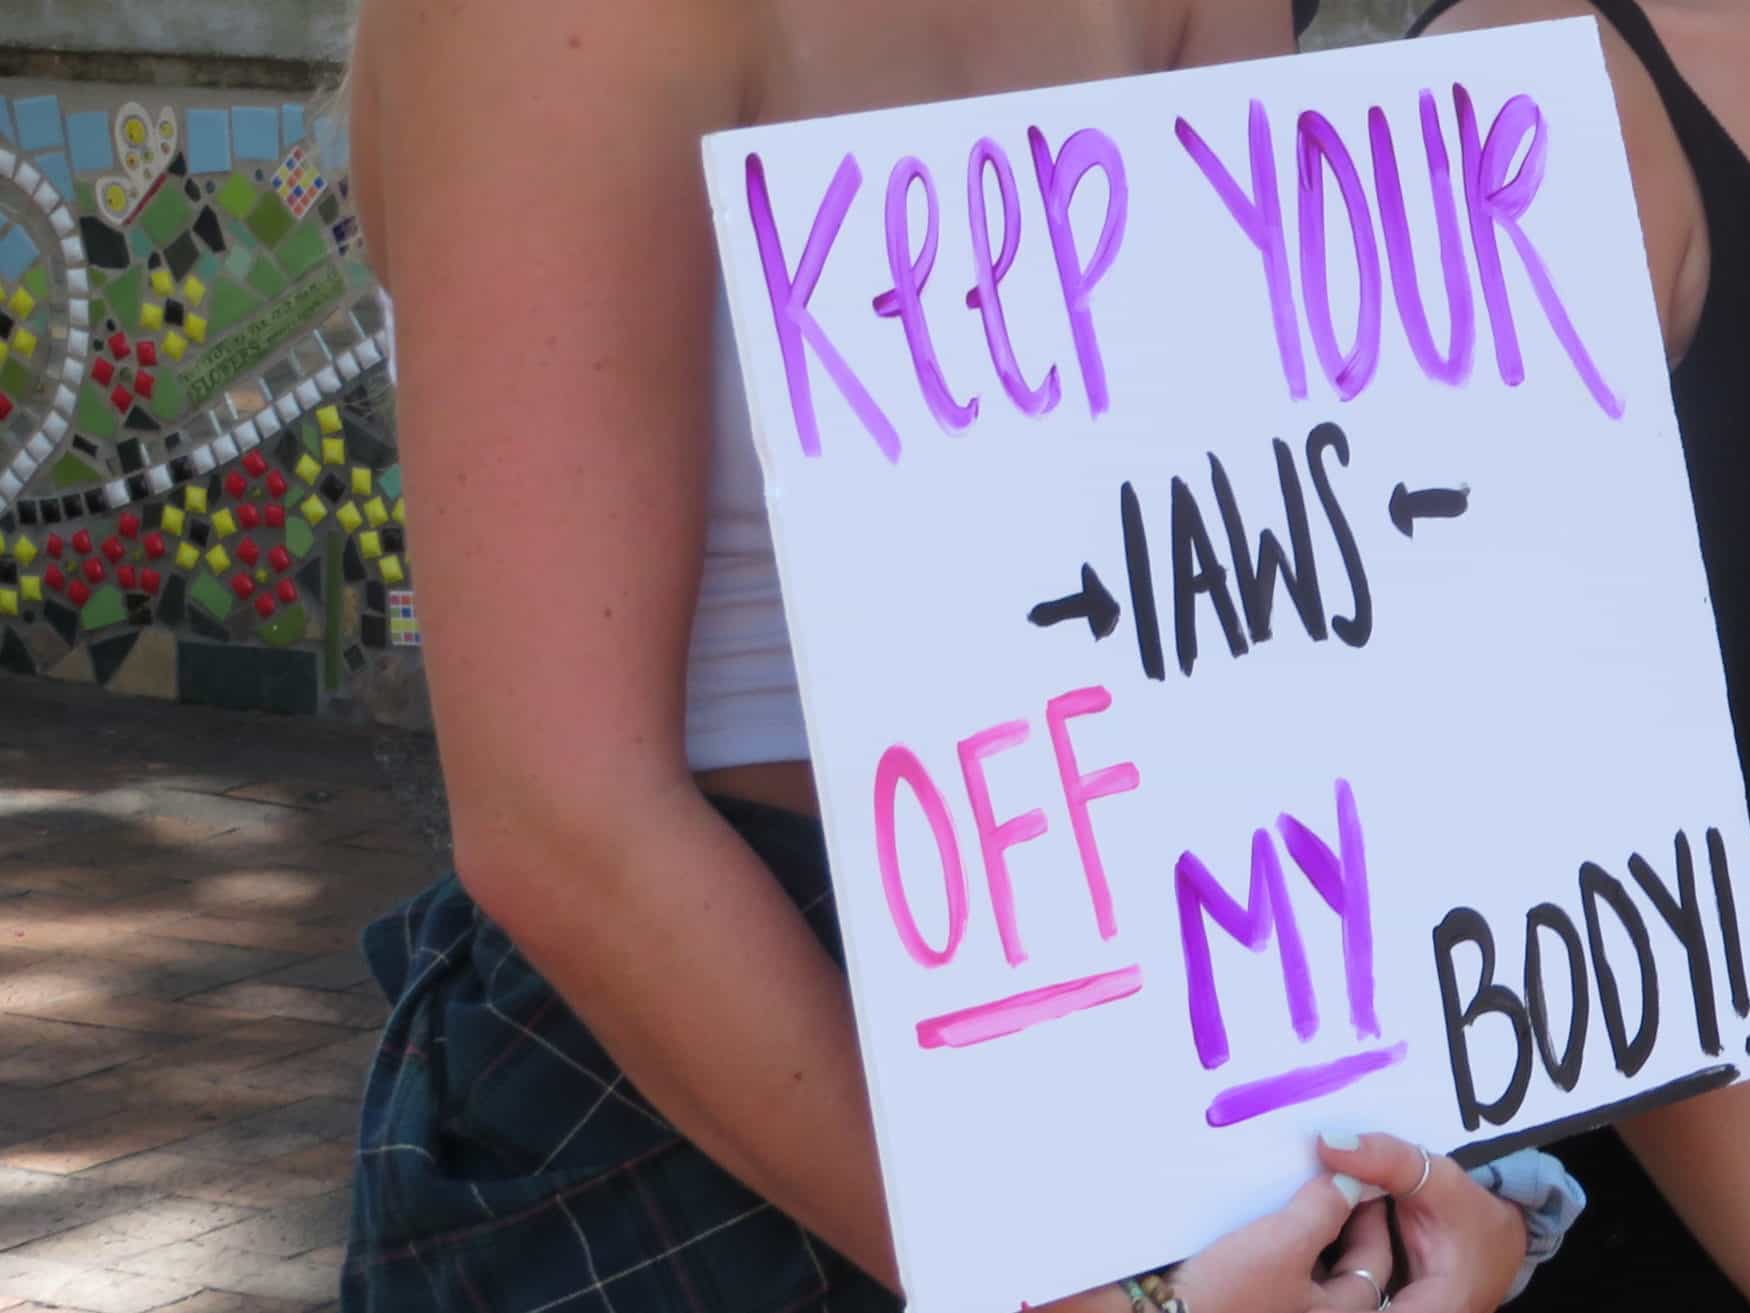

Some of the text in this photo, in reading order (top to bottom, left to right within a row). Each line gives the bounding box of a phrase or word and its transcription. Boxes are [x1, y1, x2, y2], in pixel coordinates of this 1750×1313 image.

[1175, 82, 1625, 420] YOUR
[873, 685, 1141, 968] OFF
[1175, 777, 1382, 1070] MY
